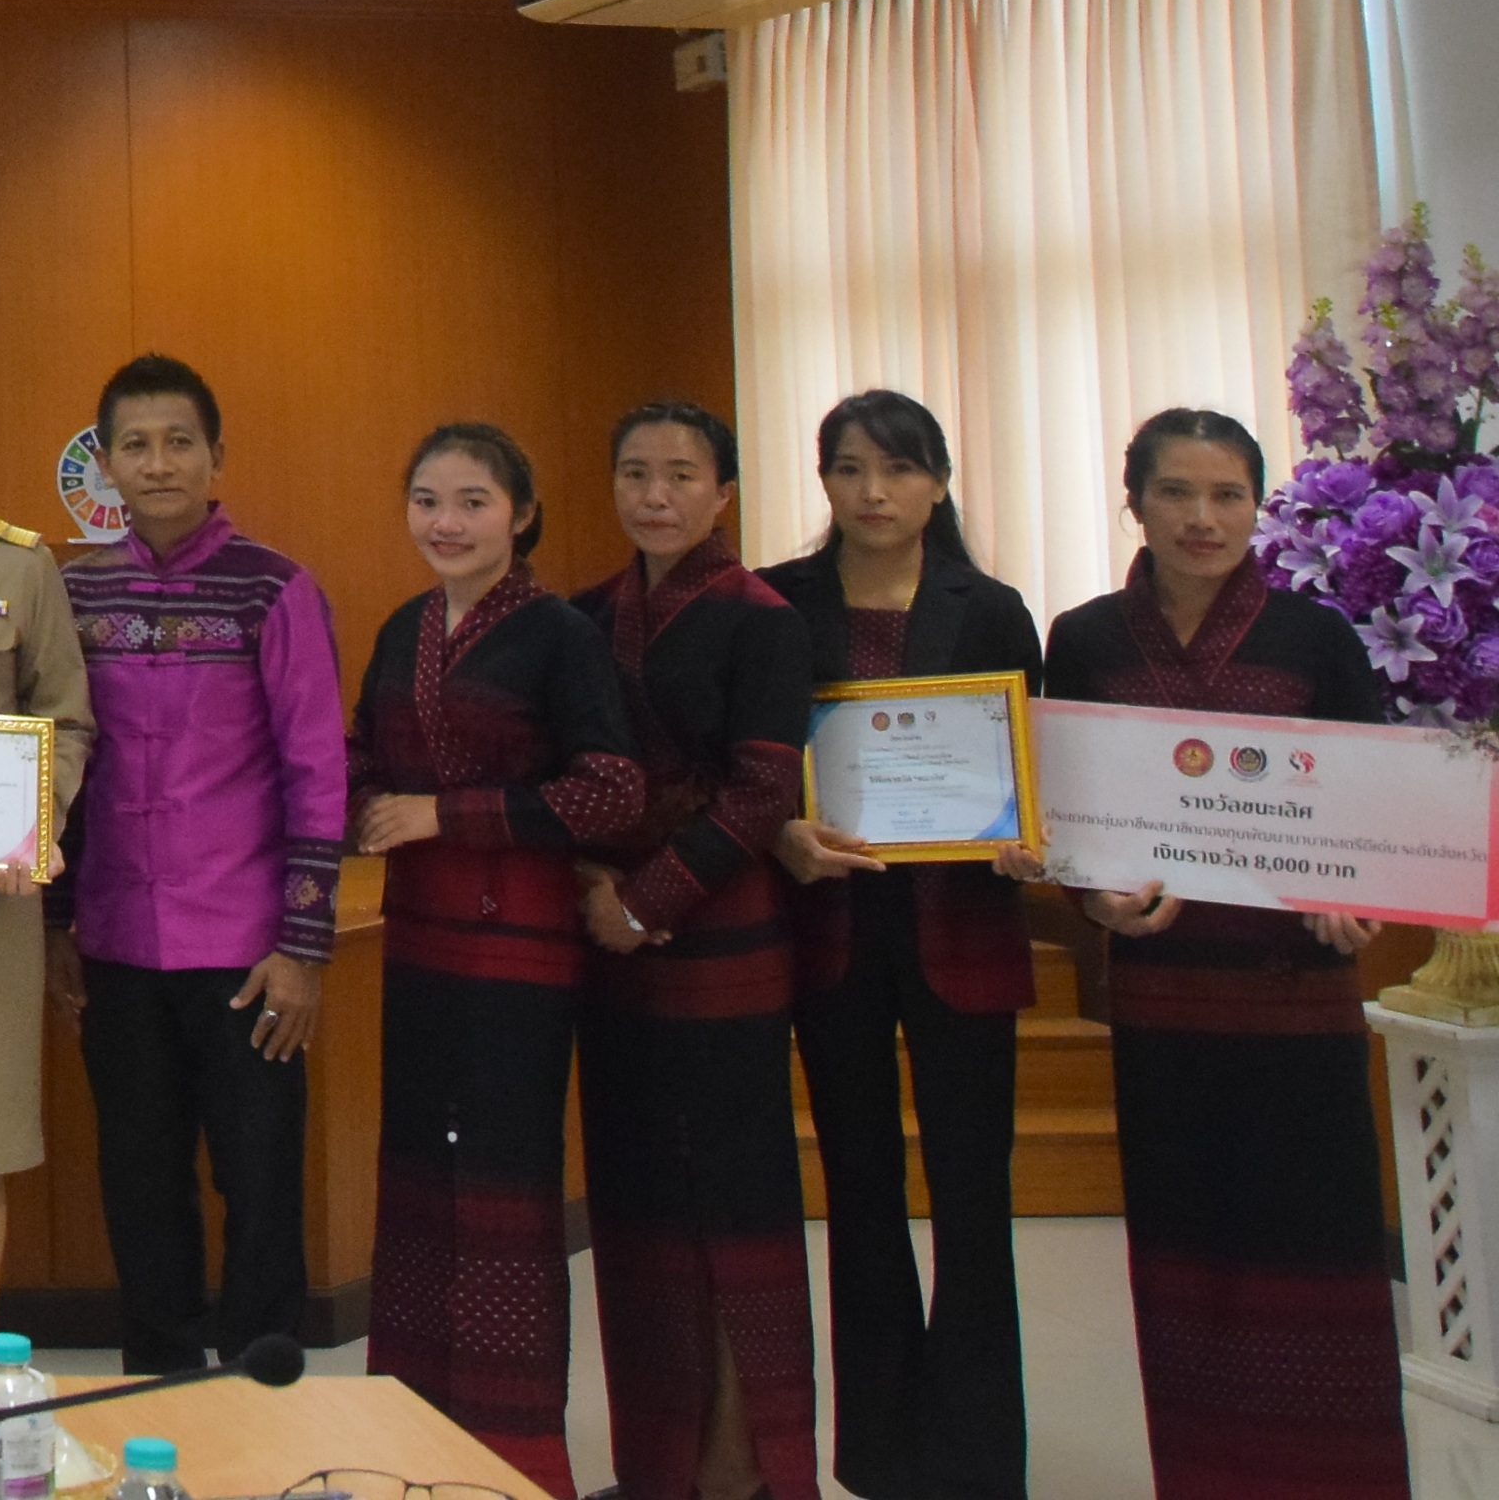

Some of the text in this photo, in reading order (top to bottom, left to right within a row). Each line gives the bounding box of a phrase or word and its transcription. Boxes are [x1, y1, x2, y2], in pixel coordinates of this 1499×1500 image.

[1180, 793, 1313, 819] รางวัลชนะเลิศ
[1153, 842, 1356, 878] เงินรางวัล 8,000 บาท
[1402, 843, 1488, 863] ระดับจังหวัด
